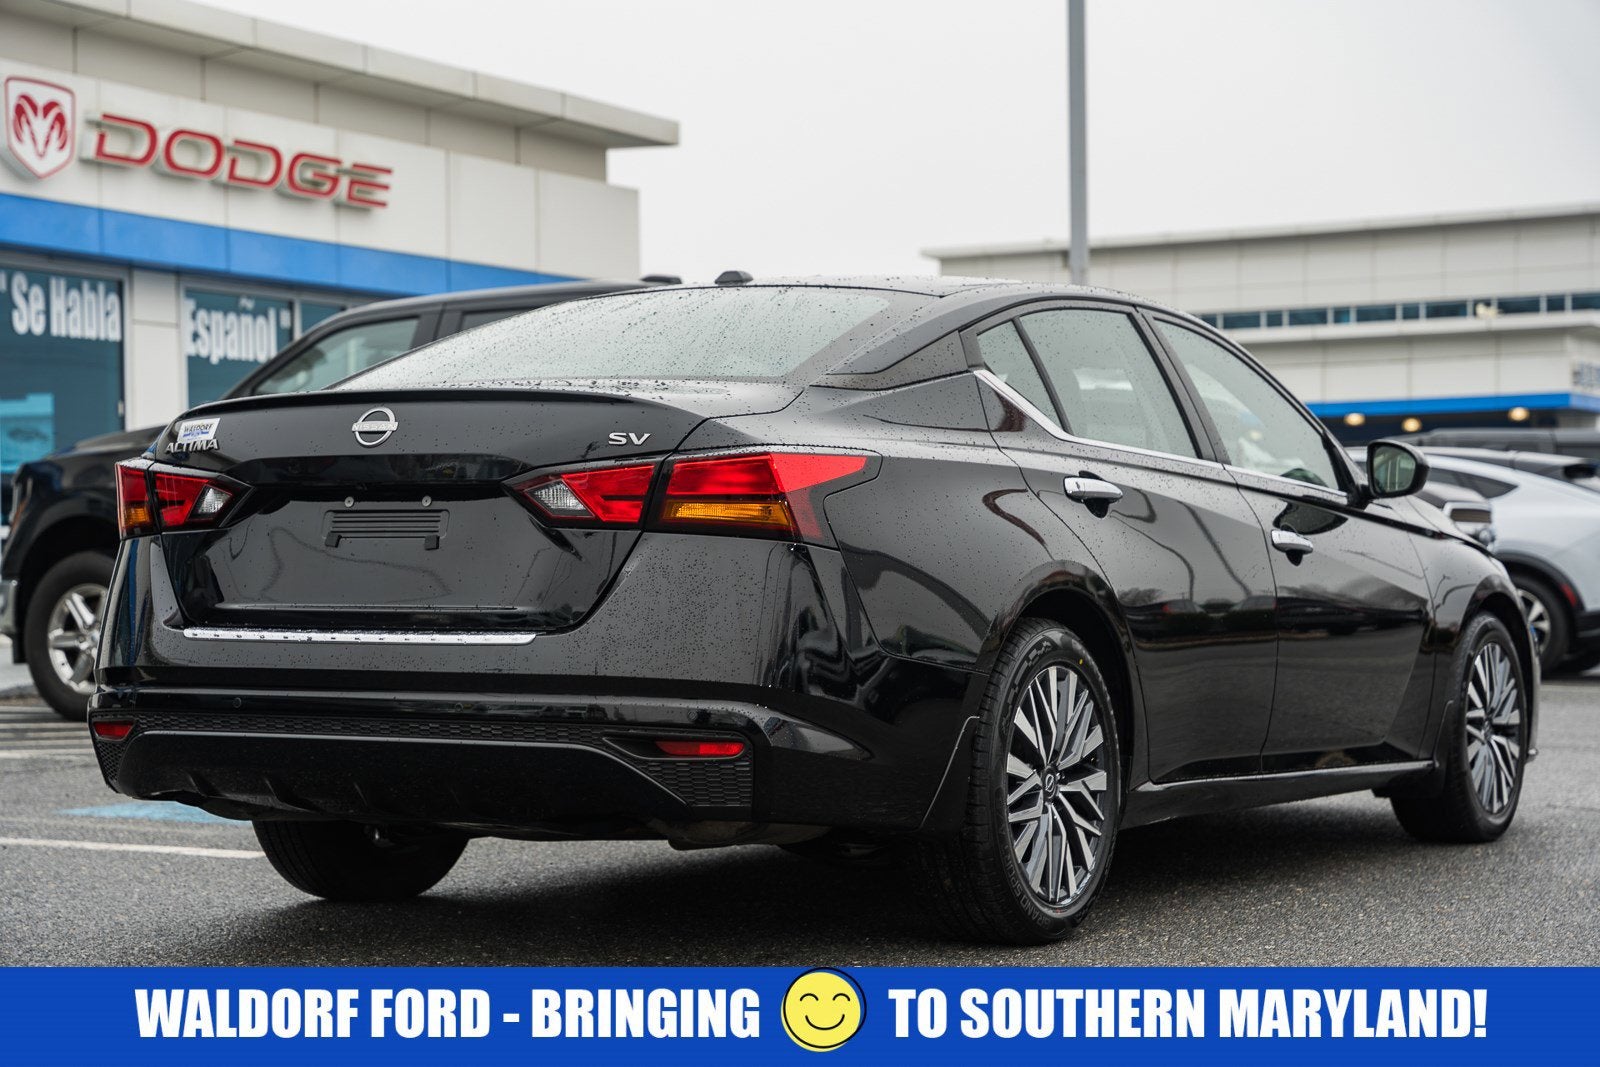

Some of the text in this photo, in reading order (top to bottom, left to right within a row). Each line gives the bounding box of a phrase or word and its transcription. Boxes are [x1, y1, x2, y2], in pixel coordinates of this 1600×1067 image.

[94, 113, 393, 208] DODGE
[49, 276, 121, 342] Habla
[352, 421, 398, 431] NISSAN
[164, 438, 219, 453] ALTIMA
[608, 432, 651, 446] SV
